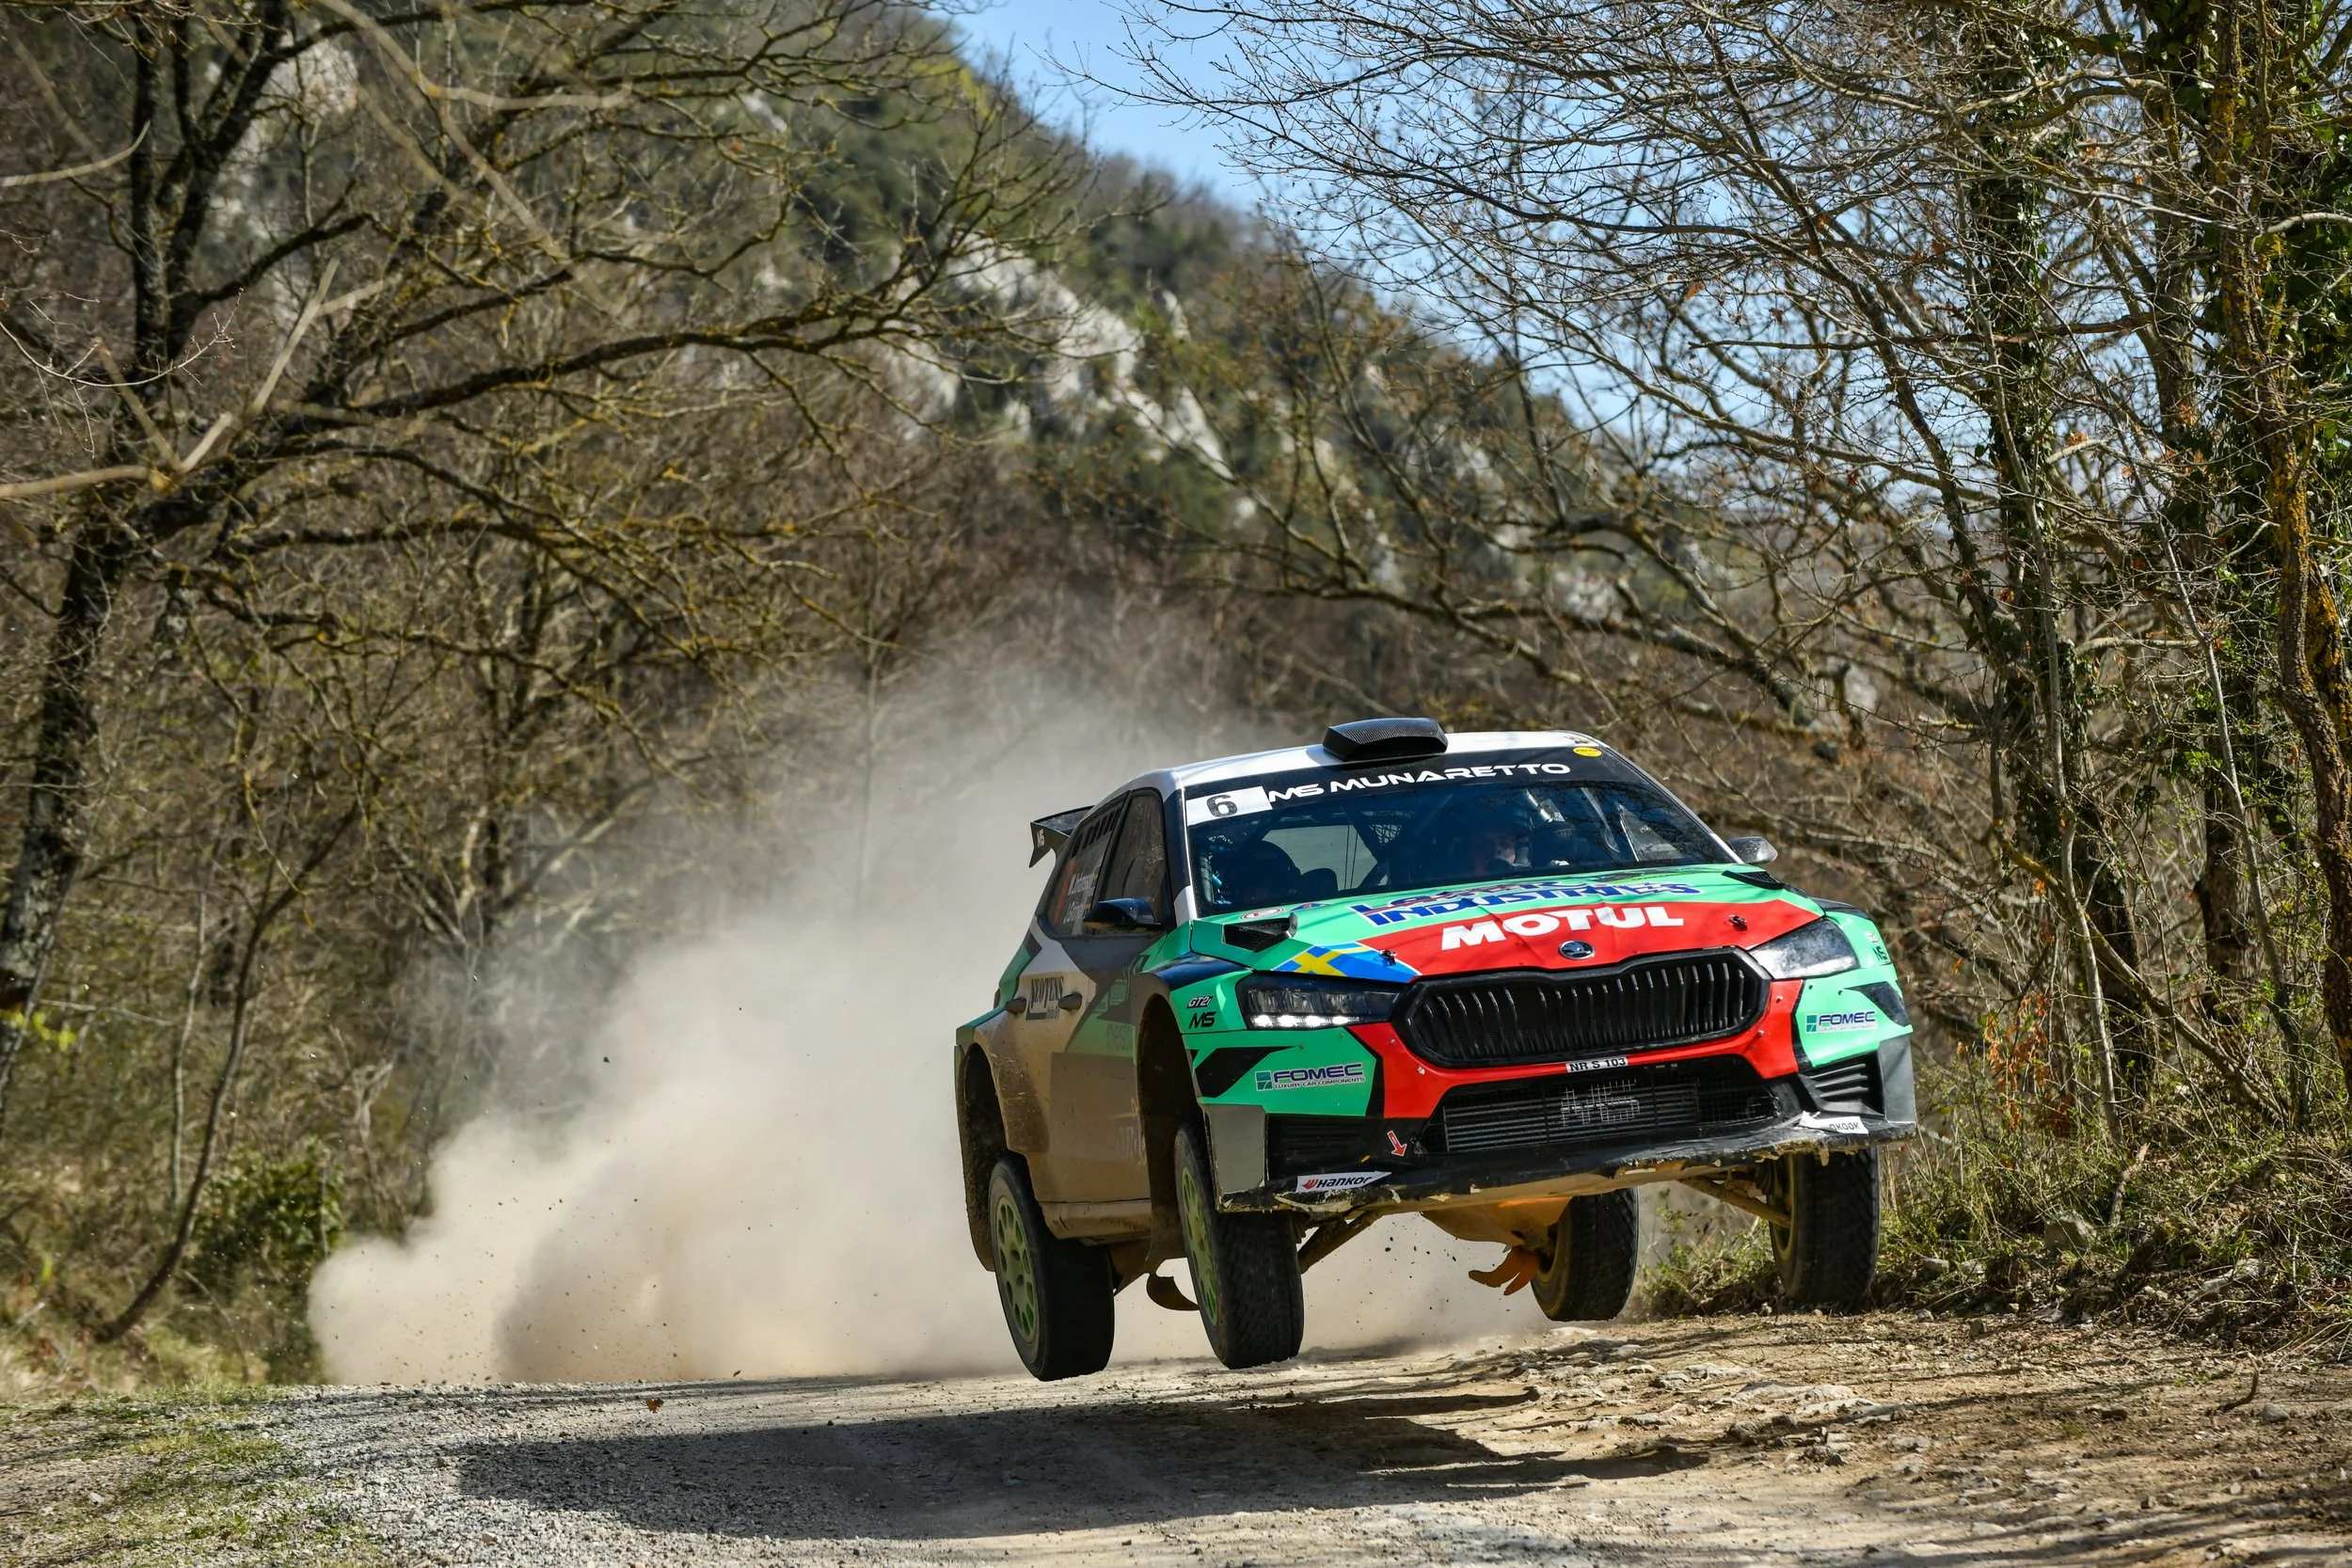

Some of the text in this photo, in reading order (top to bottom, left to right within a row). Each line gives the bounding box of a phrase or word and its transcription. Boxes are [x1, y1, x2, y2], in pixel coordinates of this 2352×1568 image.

[1268, 763, 1571, 802] MS MUNARETTO
[1206, 794, 1238, 817] 6
[1367, 882, 1700, 926] INDUSTRIES
[1441, 906, 1684, 950] MOTUL
[1188, 1011, 1217, 1030] MS
[1819, 1011, 1875, 1026] FOMEC
[1273, 1064, 1363, 1083] FOMEC
[1569, 1057, 1627, 1072] NR S 103
[1317, 1077, 1365, 1085] COMPONENTS
